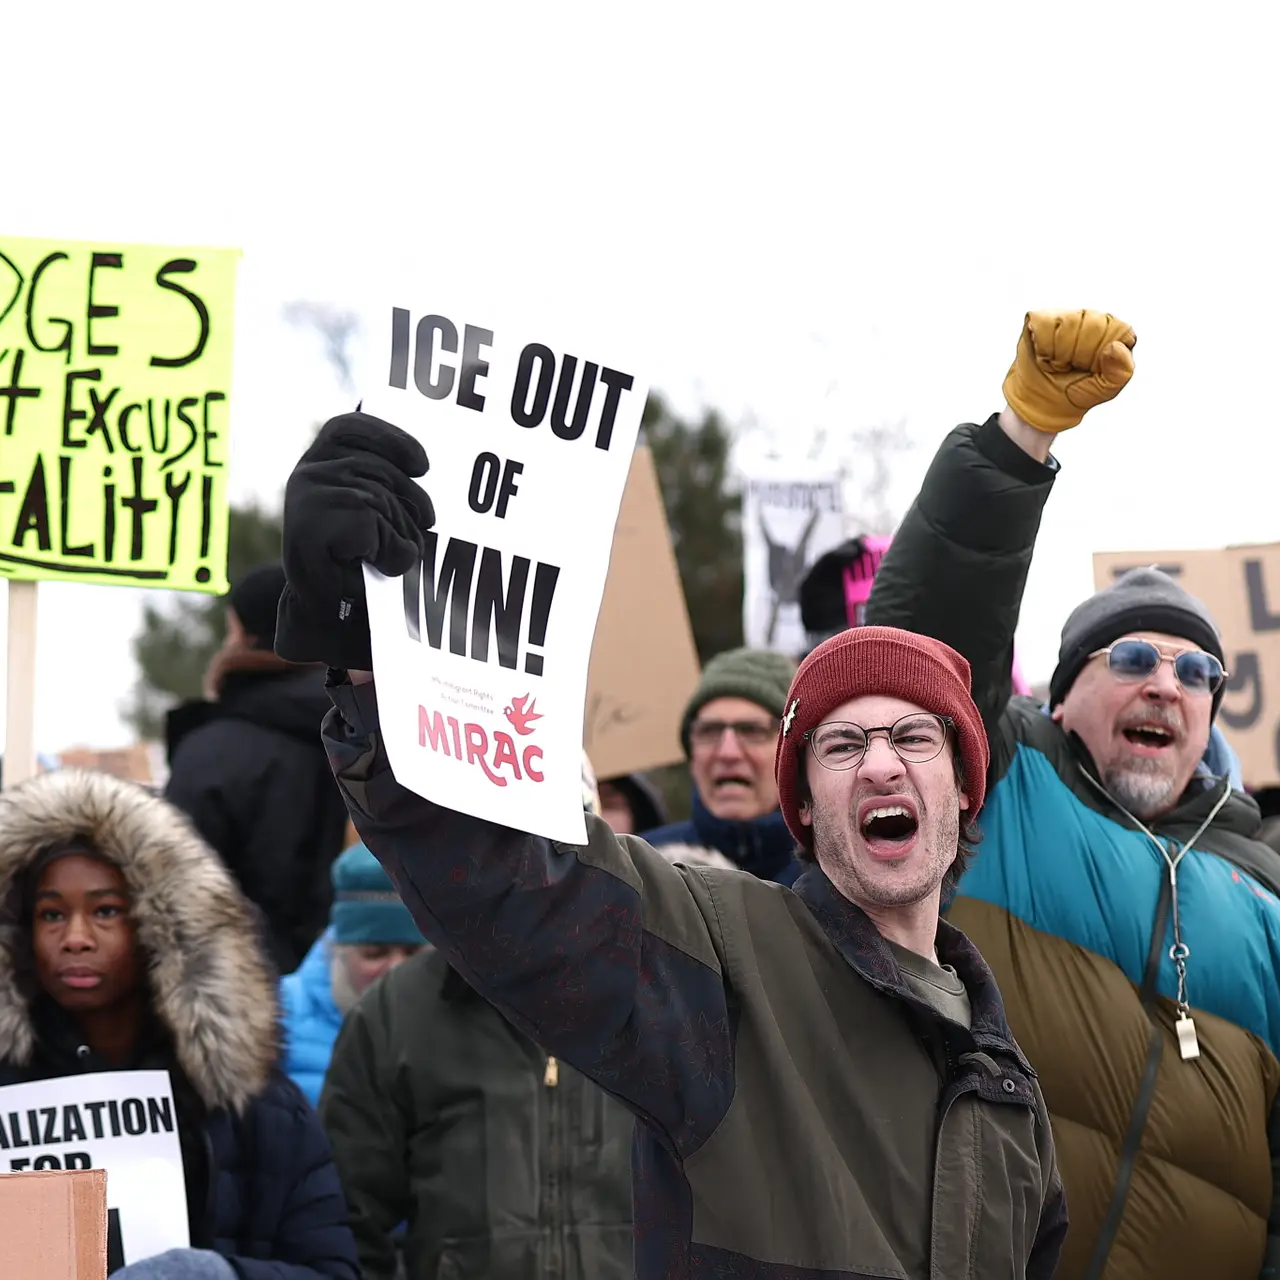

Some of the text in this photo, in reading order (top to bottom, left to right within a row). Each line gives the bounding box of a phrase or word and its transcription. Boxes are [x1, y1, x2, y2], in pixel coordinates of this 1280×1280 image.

[62, 369, 226, 471] EXCUSE
[388, 306, 635, 451] ICE OUT
[467, 451, 524, 519] OF
[403, 529, 561, 677] MN!
[417, 704, 545, 787] MIRAC
